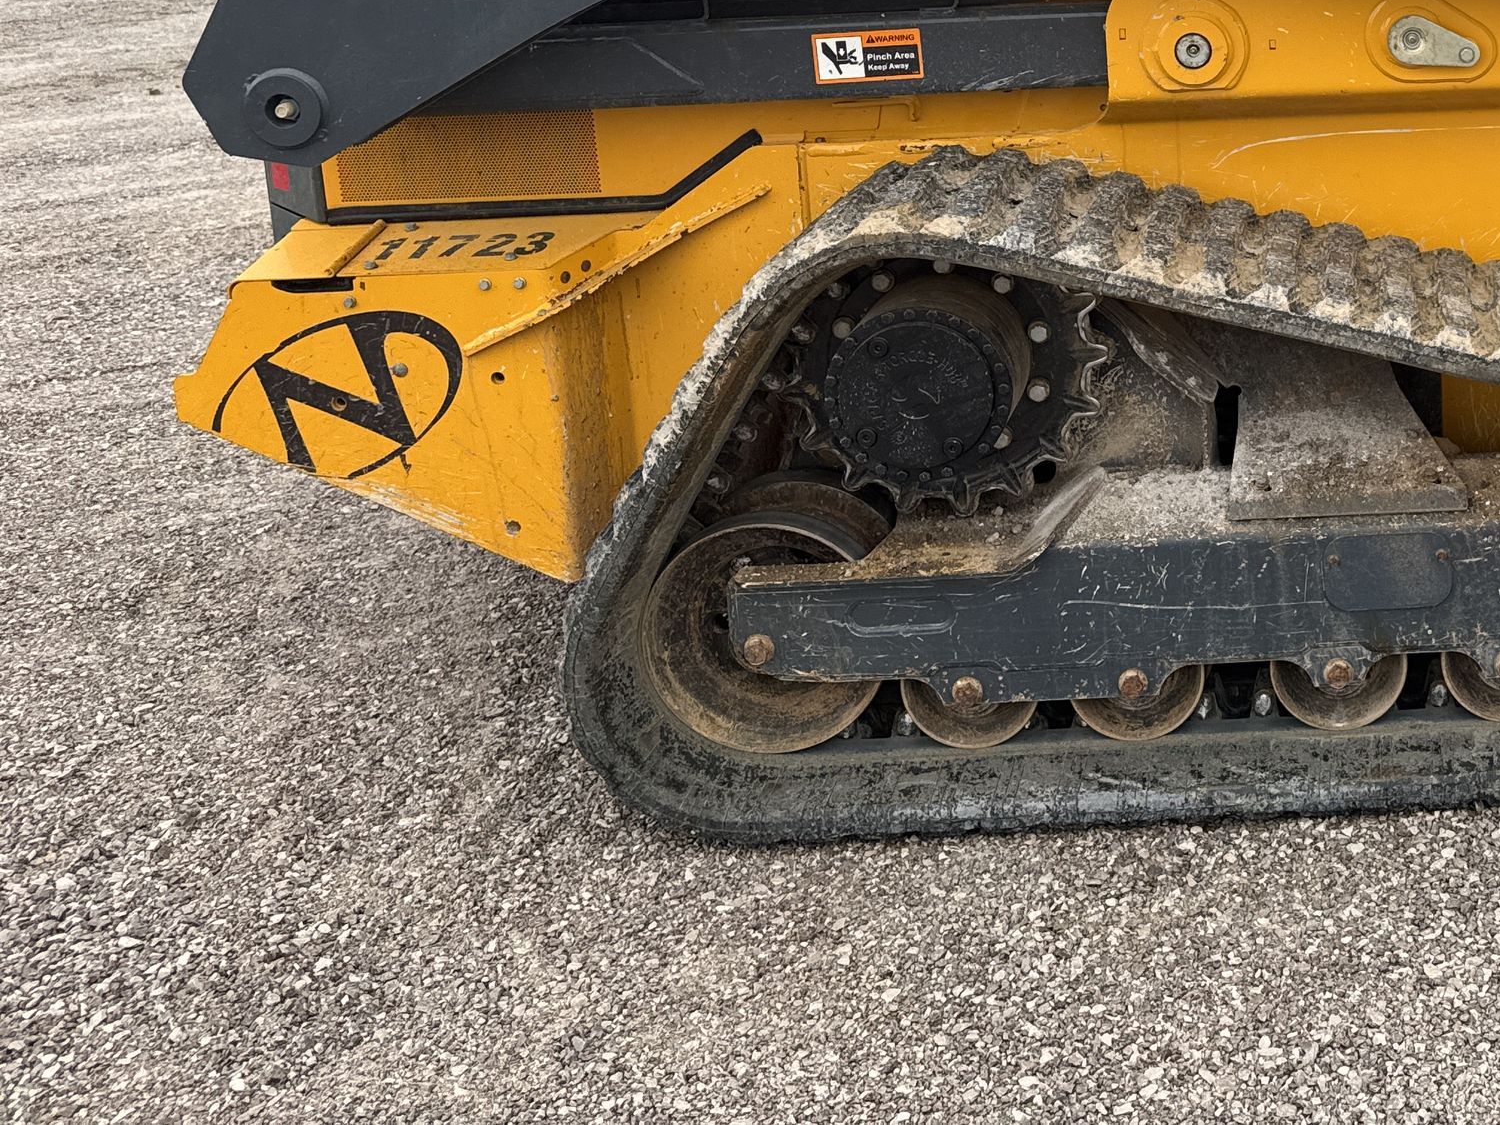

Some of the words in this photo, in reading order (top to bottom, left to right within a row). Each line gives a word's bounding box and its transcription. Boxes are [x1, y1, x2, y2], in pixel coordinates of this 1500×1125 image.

[874, 33, 915, 43] WARNING
[867, 51, 892, 61] Pinch
[894, 52, 915, 60] Area
[868, 63, 888, 72] Keep
[889, 62, 909, 70] Away
[375, 231, 556, 261] 11723
